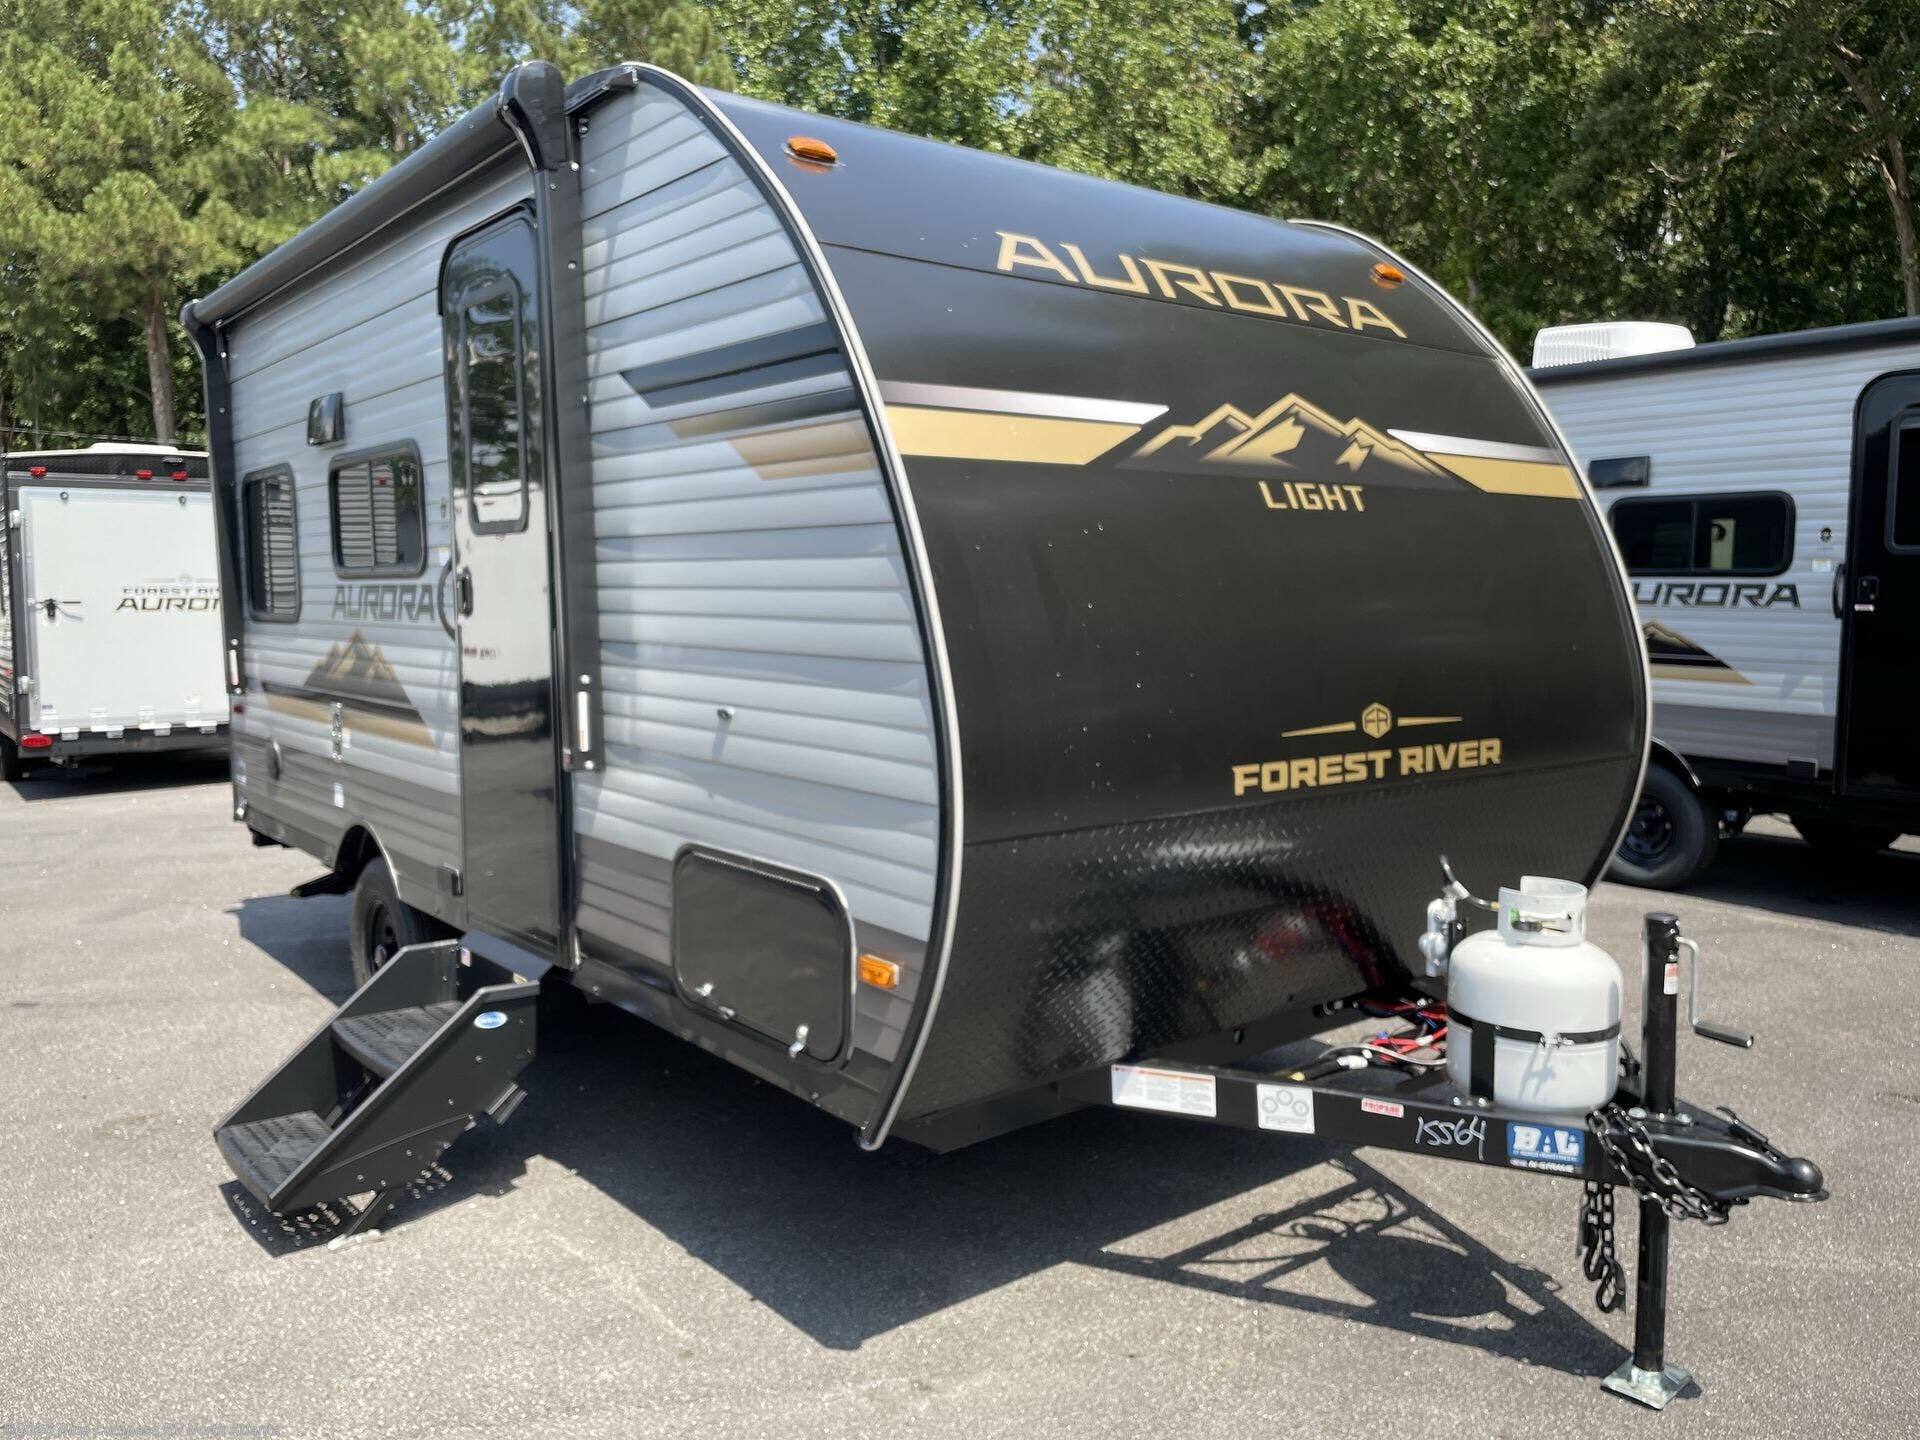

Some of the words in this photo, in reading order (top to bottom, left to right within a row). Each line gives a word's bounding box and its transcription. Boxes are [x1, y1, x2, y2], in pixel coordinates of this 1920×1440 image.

[995, 231, 1407, 339] AURORA
[1258, 480, 1365, 513] LIGHT
[116, 598, 218, 611] AURO
[332, 585, 435, 623] AURORA
[1632, 583, 1801, 609] URORA
[1232, 749, 1392, 796] FOREST
[1398, 738, 1502, 776] RIVER
